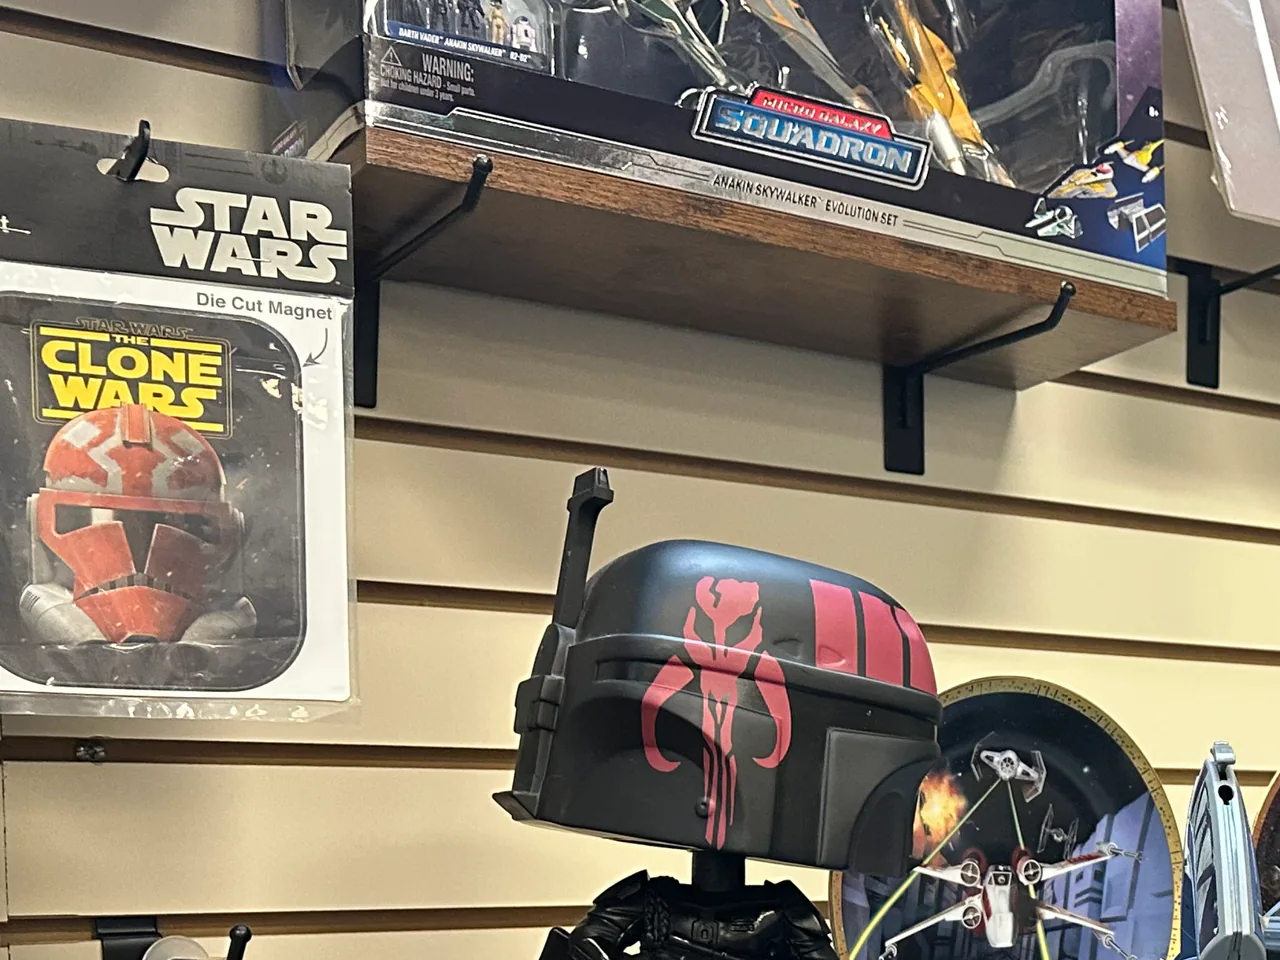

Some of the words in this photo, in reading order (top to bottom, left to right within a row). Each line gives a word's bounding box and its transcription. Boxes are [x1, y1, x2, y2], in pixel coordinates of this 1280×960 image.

[444, 38, 467, 50] ANAKIN
[380, 64, 412, 82] CHOKING
[413, 70, 441, 88] HAZARD
[422, 53, 474, 82] WARNING:
[762, 97, 815, 117] MICRO
[818, 110, 882, 134] GALAXY
[715, 106, 912, 173] SQUADRON
[150, 187, 347, 245] STAR
[713, 174, 753, 194] ANAKIN
[755, 182, 817, 209] SKYWALKER
[825, 199, 879, 223] EVOLUTION
[881, 214, 898, 228] SET
[151, 224, 347, 284] WARS
[196, 292, 226, 309] Die
[231, 296, 263, 313] Cut
[269, 301, 333, 321] Magnet
[76, 317, 128, 335] STAR
[129, 321, 194, 340] WARS
[112, 334, 149, 346] THE
[41, 340, 222, 387] CLONE
[48, 373, 217, 419] WARS
